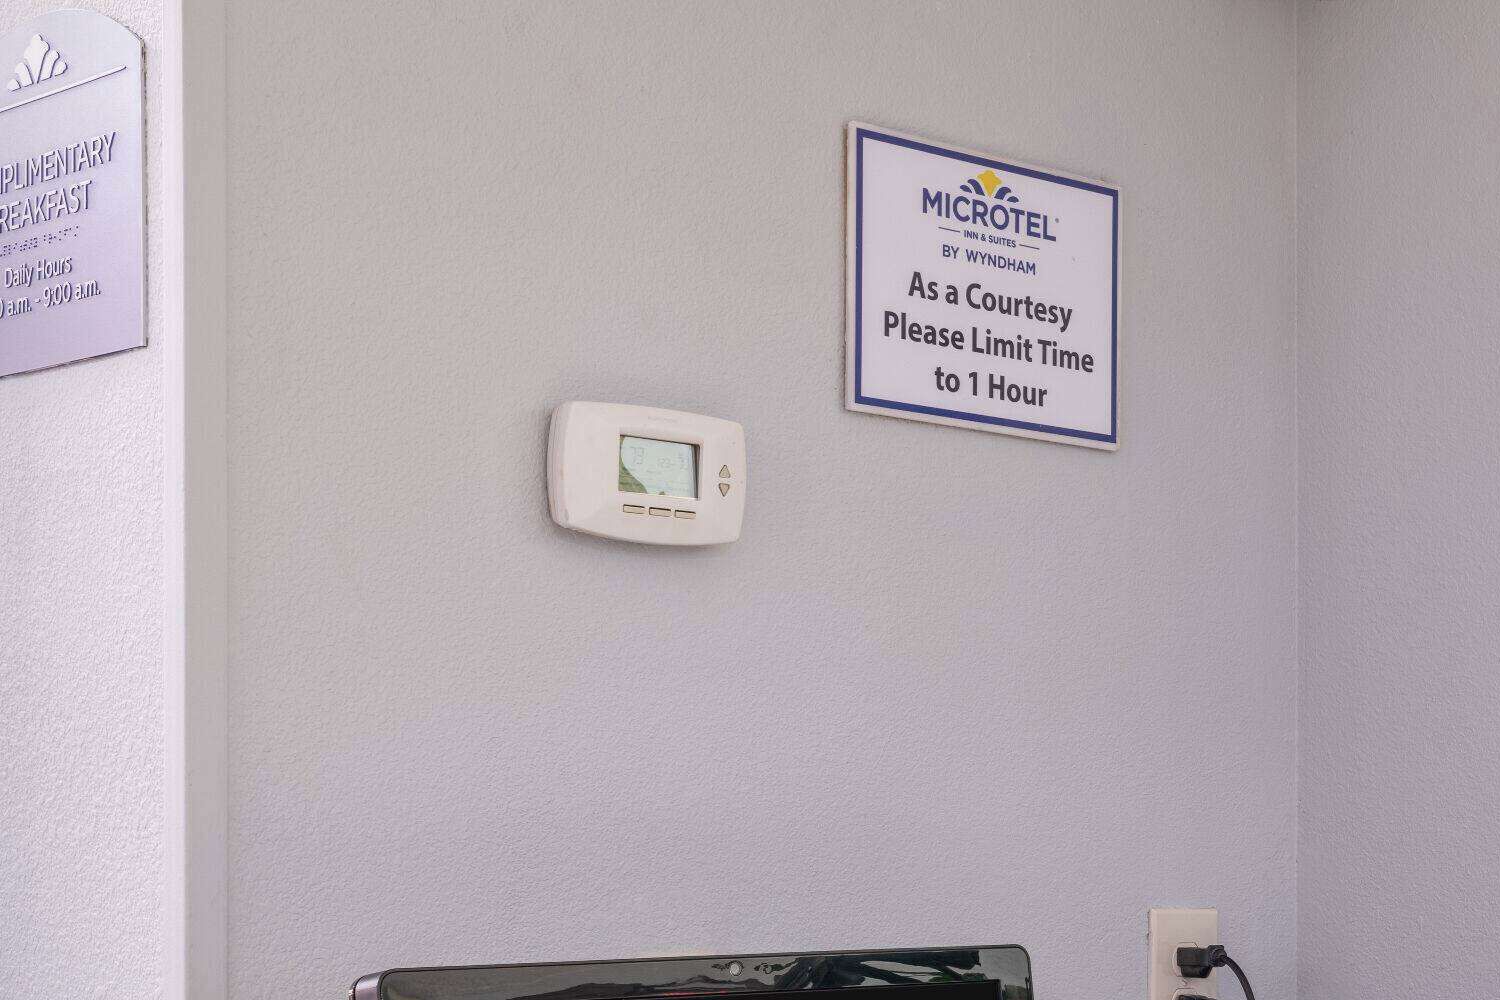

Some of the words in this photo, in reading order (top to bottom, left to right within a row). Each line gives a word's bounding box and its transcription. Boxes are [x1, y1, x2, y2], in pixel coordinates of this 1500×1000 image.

[0, 131, 117, 194] PLIMENTARY
[922, 187, 1057, 242] MICROTEL
[964, 229, 979, 241] INN
[981, 233, 987, 242] &
[988, 235, 1016, 248] SUITES
[5, 263, 34, 288] Daily
[36, 256, 72, 280] Hours
[942, 244, 959, 260] BY
[966, 249, 1037, 275] WYNDHAM
[8, 297, 32, 316] a.m.
[43, 281, 72, 308] 9:00
[75, 279, 101, 300] a.m.
[908, 271, 938, 301] As
[945, 284, 959, 305] a
[965, 283, 1073, 332] Courtesy
[883, 310, 965, 350] Please
[971, 327, 1033, 363] Limit
[1037, 339, 1095, 373] Time
[934, 366, 960, 393] to
[968, 371, 979, 397] 1
[988, 373, 1048, 407] Hour
